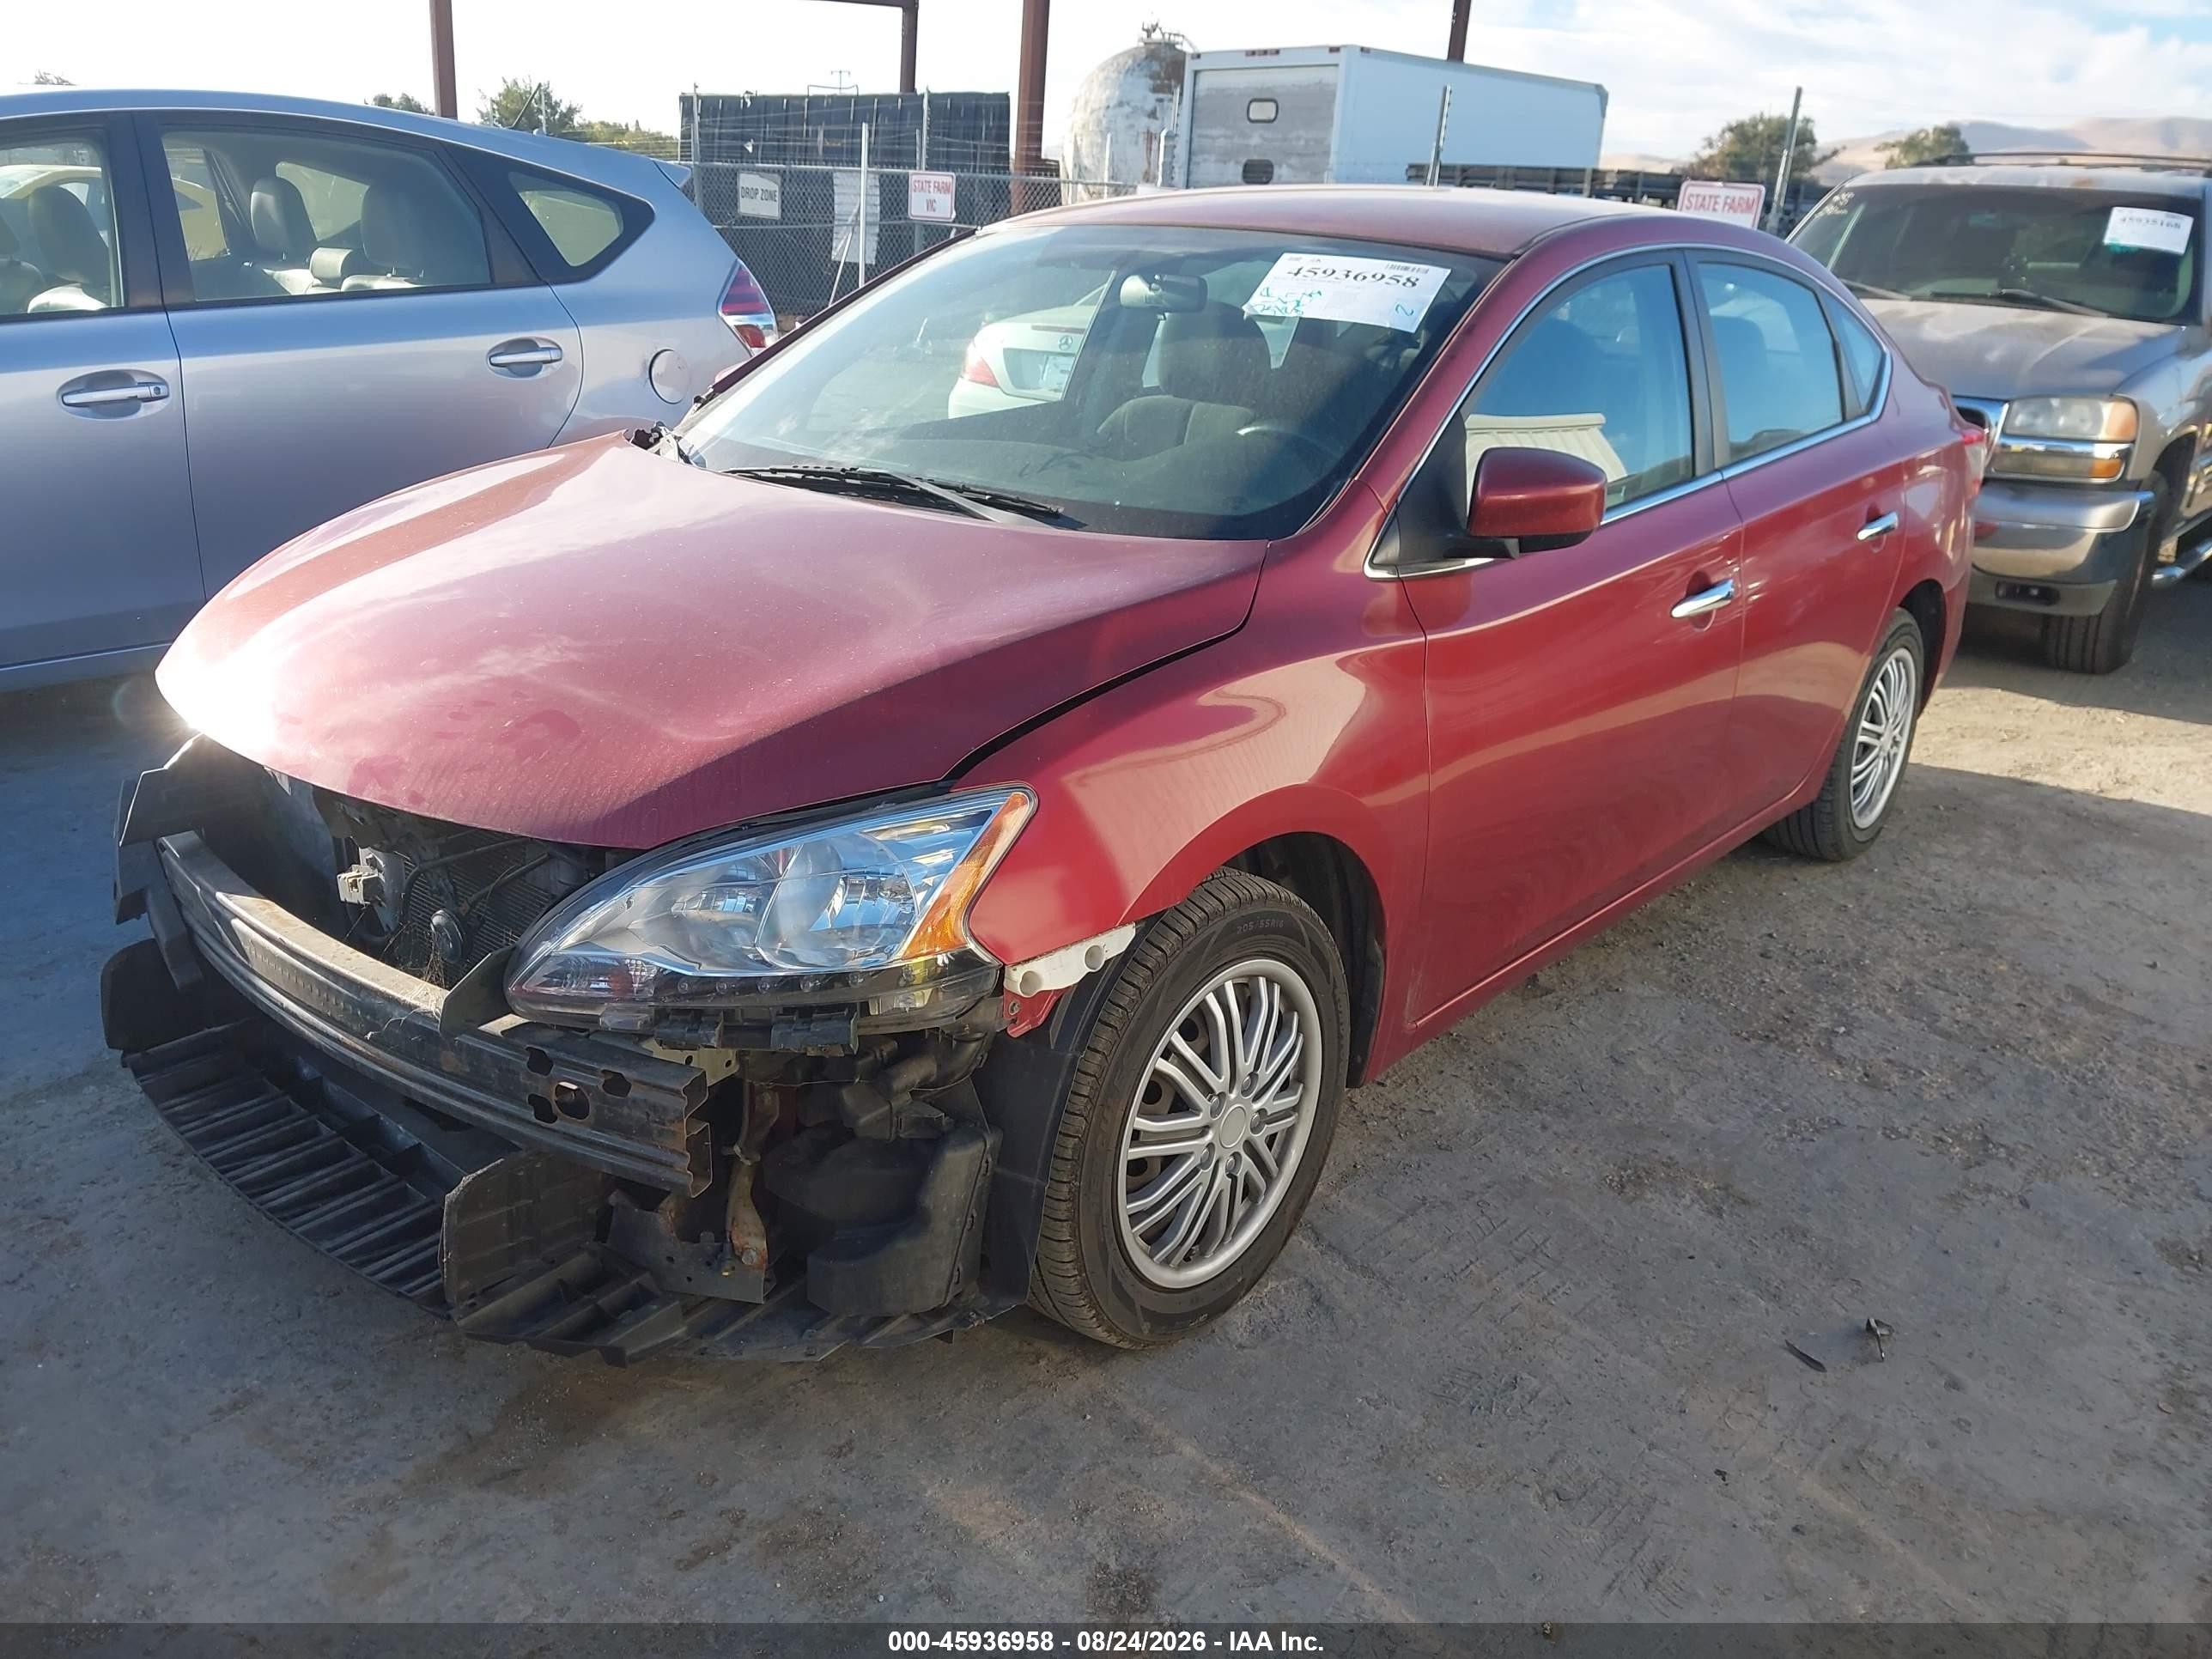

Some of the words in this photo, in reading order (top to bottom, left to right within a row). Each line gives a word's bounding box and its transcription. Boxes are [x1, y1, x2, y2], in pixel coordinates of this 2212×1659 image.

[740, 185, 758, 200] DROP
[760, 188, 778, 203] ZONE
[913, 179, 933, 193] STATE
[933, 179, 952, 195] FARM
[1685, 193, 1721, 212] STATE
[1722, 195, 1756, 214] FARM
[1286, 265, 1419, 289] 45936958
